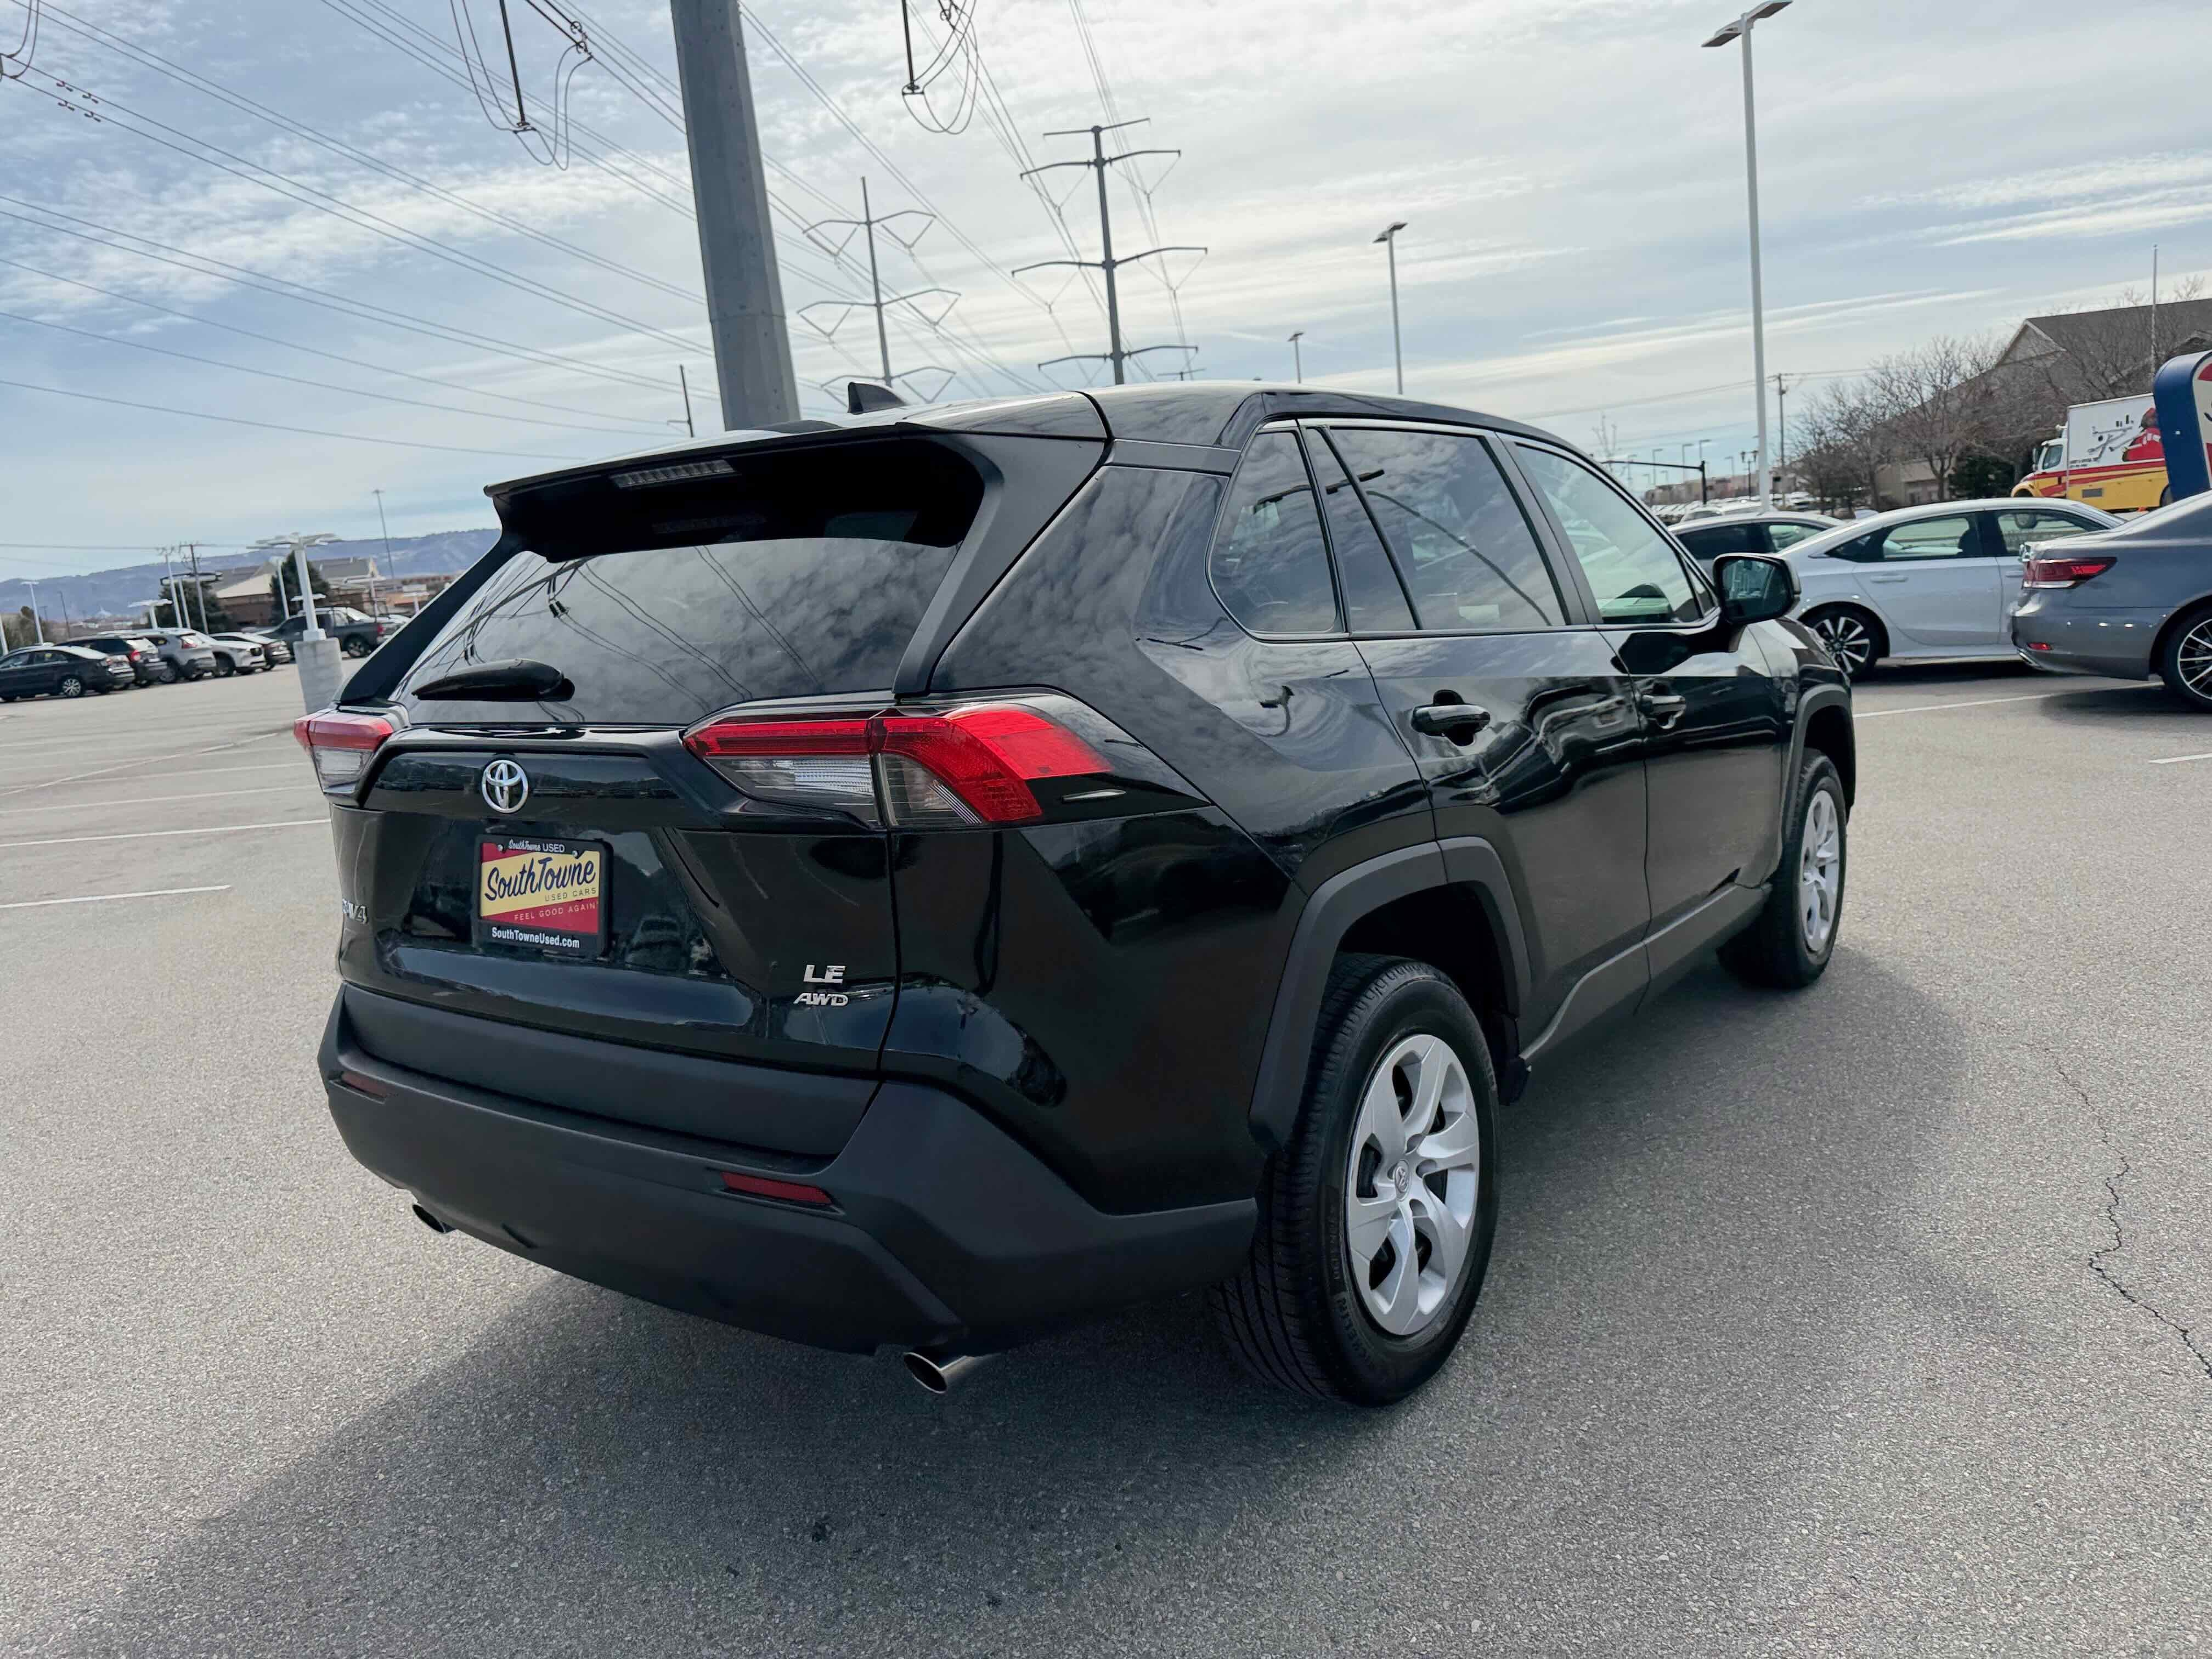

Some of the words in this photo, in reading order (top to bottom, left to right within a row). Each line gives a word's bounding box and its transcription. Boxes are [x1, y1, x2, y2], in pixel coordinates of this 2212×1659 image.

[543, 843, 565, 853] USED
[484, 857, 596, 901] SouthTowne
[545, 893, 568, 902] USED
[573, 887, 597, 897] CARS
[514, 913, 535, 921] FEEL
[539, 907, 564, 918] GOOD
[492, 927, 580, 949] SouthTowneUsed.com
[803, 964, 846, 984] LE
[793, 992, 849, 1007] AWD
